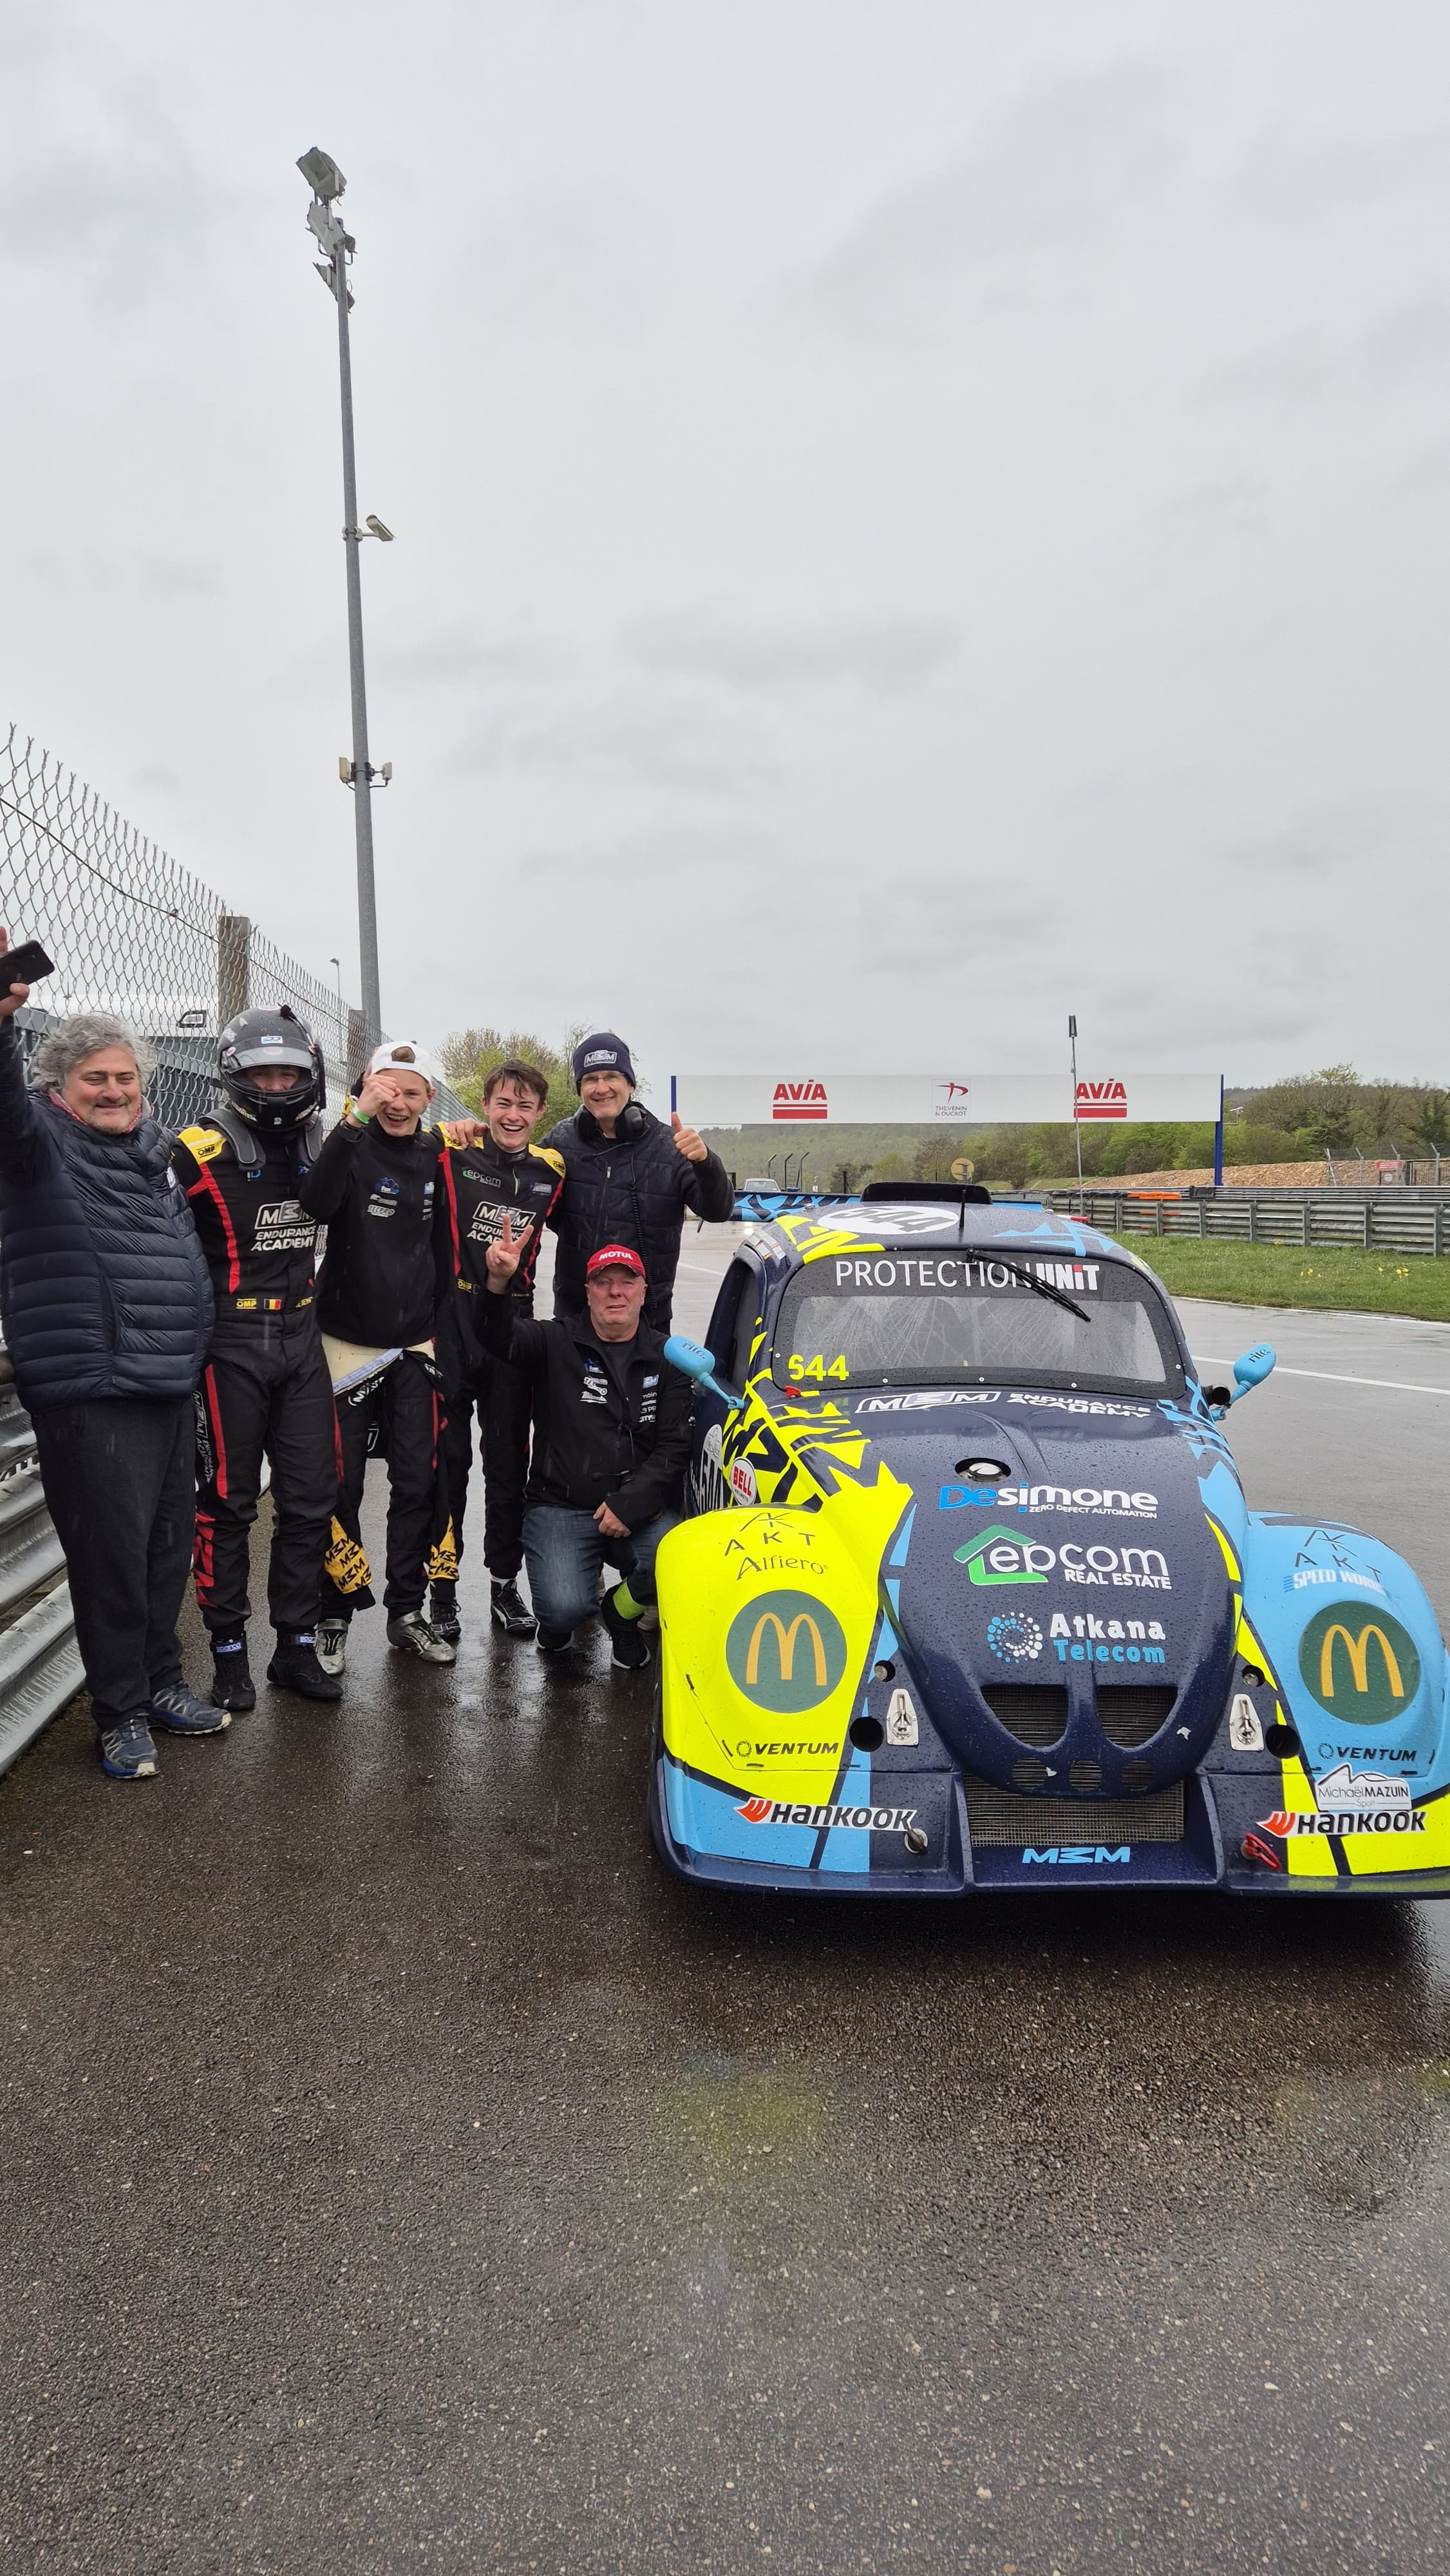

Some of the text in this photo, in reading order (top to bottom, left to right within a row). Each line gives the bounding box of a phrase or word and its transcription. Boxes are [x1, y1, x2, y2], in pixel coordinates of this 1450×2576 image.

[198, 1146, 216, 1156] OMP
[598, 1251, 634, 1261] MOTUL
[836, 1260, 1032, 1288] PROTECTION
[236, 1300, 257, 1308] OMP
[1006, 1398, 1151, 1418] ACADEMY
[1010, 1393, 1152, 1413] ENDURANCE
[732, 1465, 752, 1497] BELL
[939, 1482, 1159, 1511] Desimone
[1028, 1504, 1158, 1519] ZERO DEFECT AUTOMATION
[989, 1543, 1169, 1577] epcom
[1064, 1568, 1172, 1590] REAL ESTATE
[1294, 1569, 1337, 1589] SPEED
[1050, 1613, 1166, 1640] Atkana
[1053, 1639, 1165, 1663] Telecom
[755, 1742, 840, 1755] VENTUM
[1336, 1746, 1417, 1761] VENTUM
[1356, 1799, 1376, 1809] Sport
